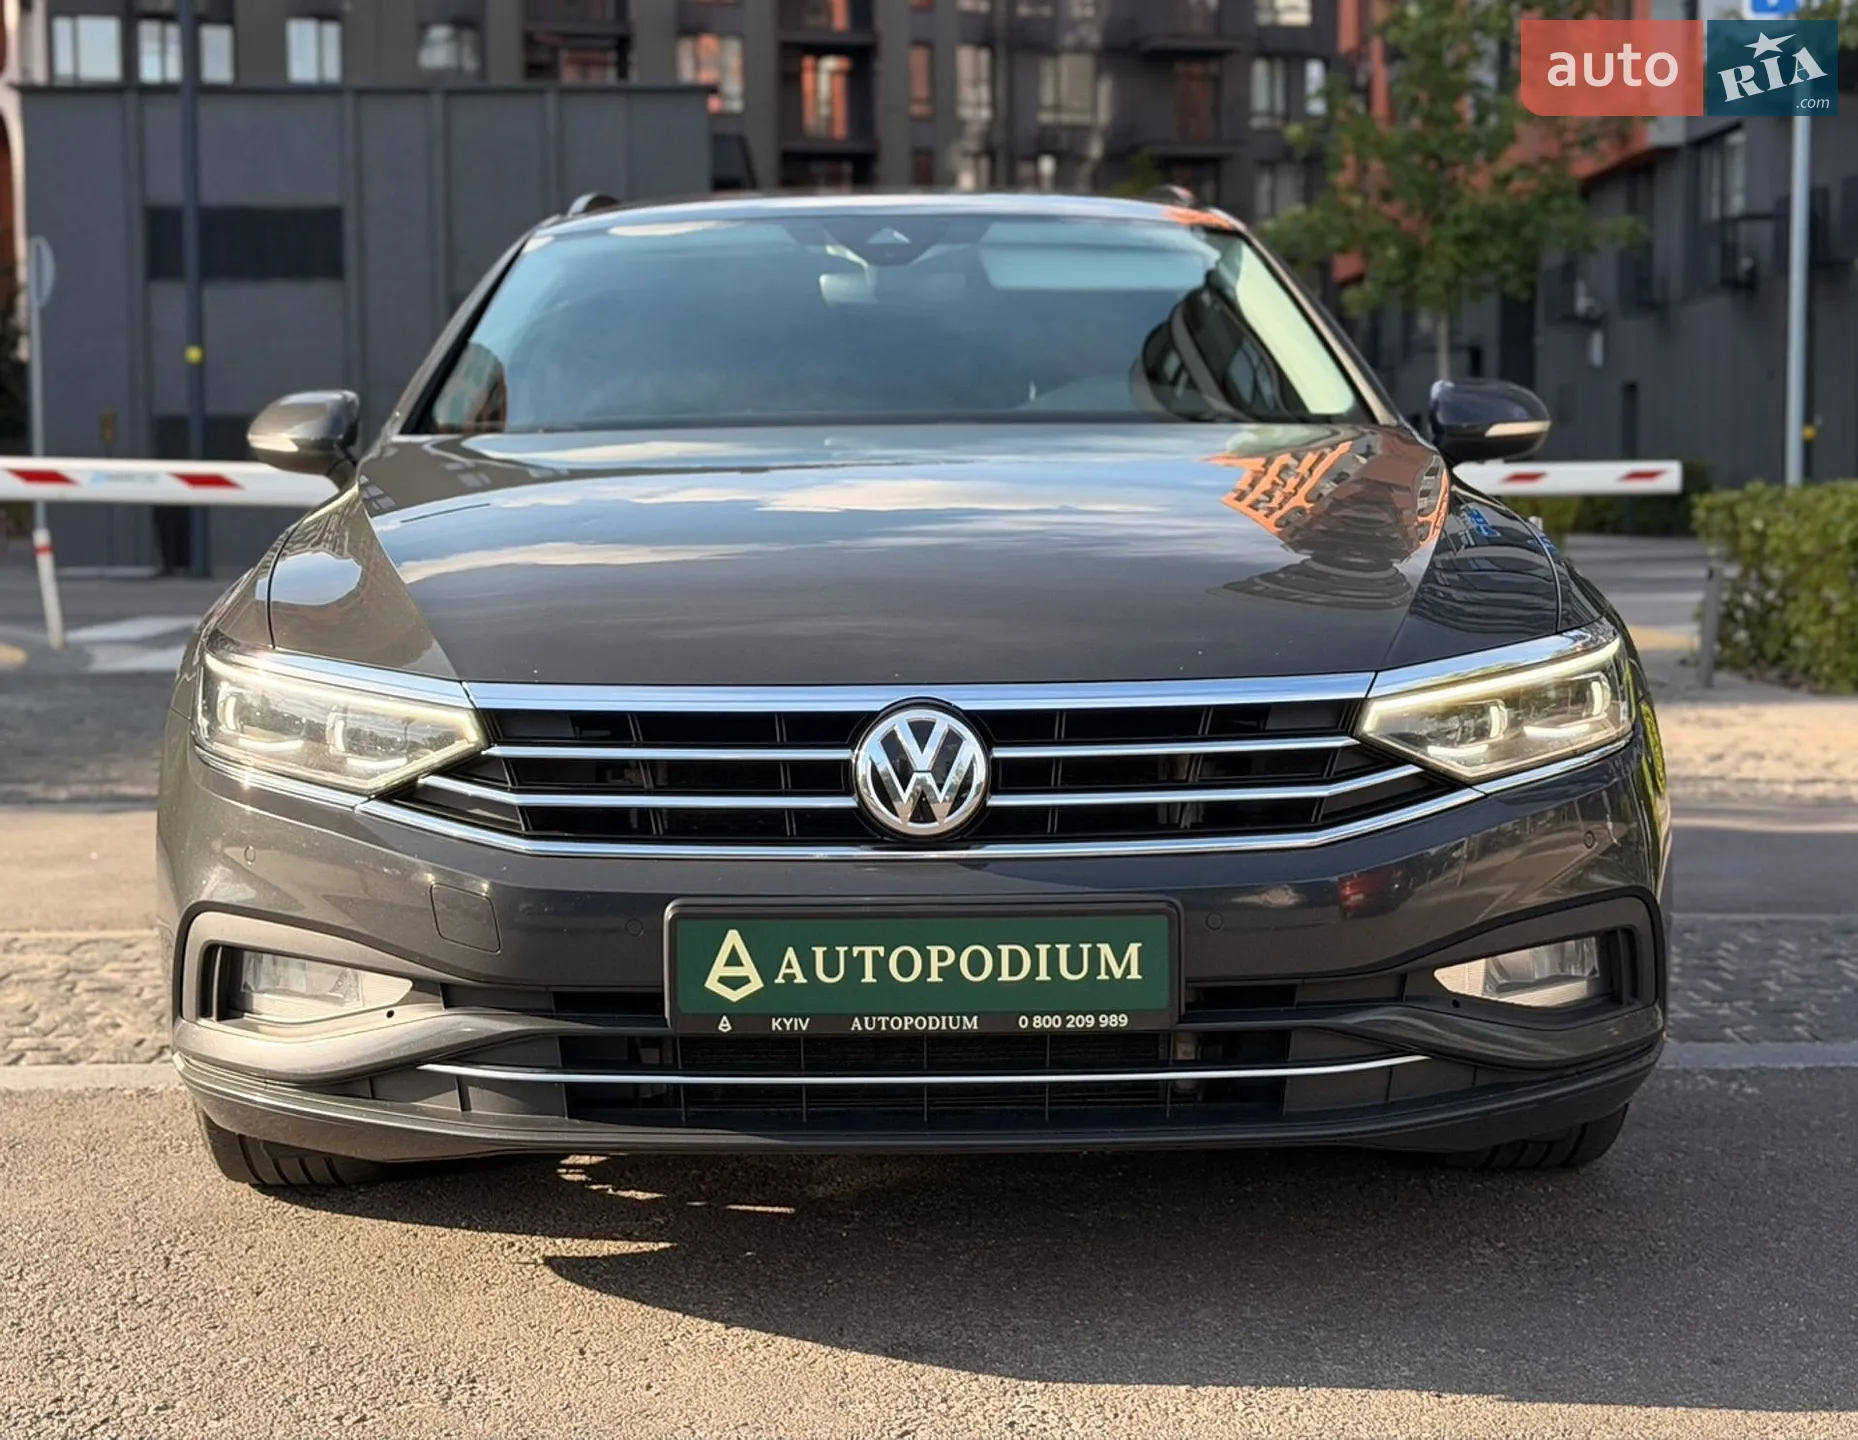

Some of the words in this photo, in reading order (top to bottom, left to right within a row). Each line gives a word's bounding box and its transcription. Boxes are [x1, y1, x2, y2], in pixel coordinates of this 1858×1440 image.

[862, 712, 980, 832] VW
[772, 942, 1142, 984] AUTOPODIUM
[771, 1017, 810, 1031] KYIV
[850, 1016, 978, 1031] AUTOPODIUM
[1018, 1015, 1028, 1029] 0
[1032, 1015, 1062, 1028] 800
[1066, 1014, 1095, 1028] 209
[1099, 1014, 1128, 1027] 989
